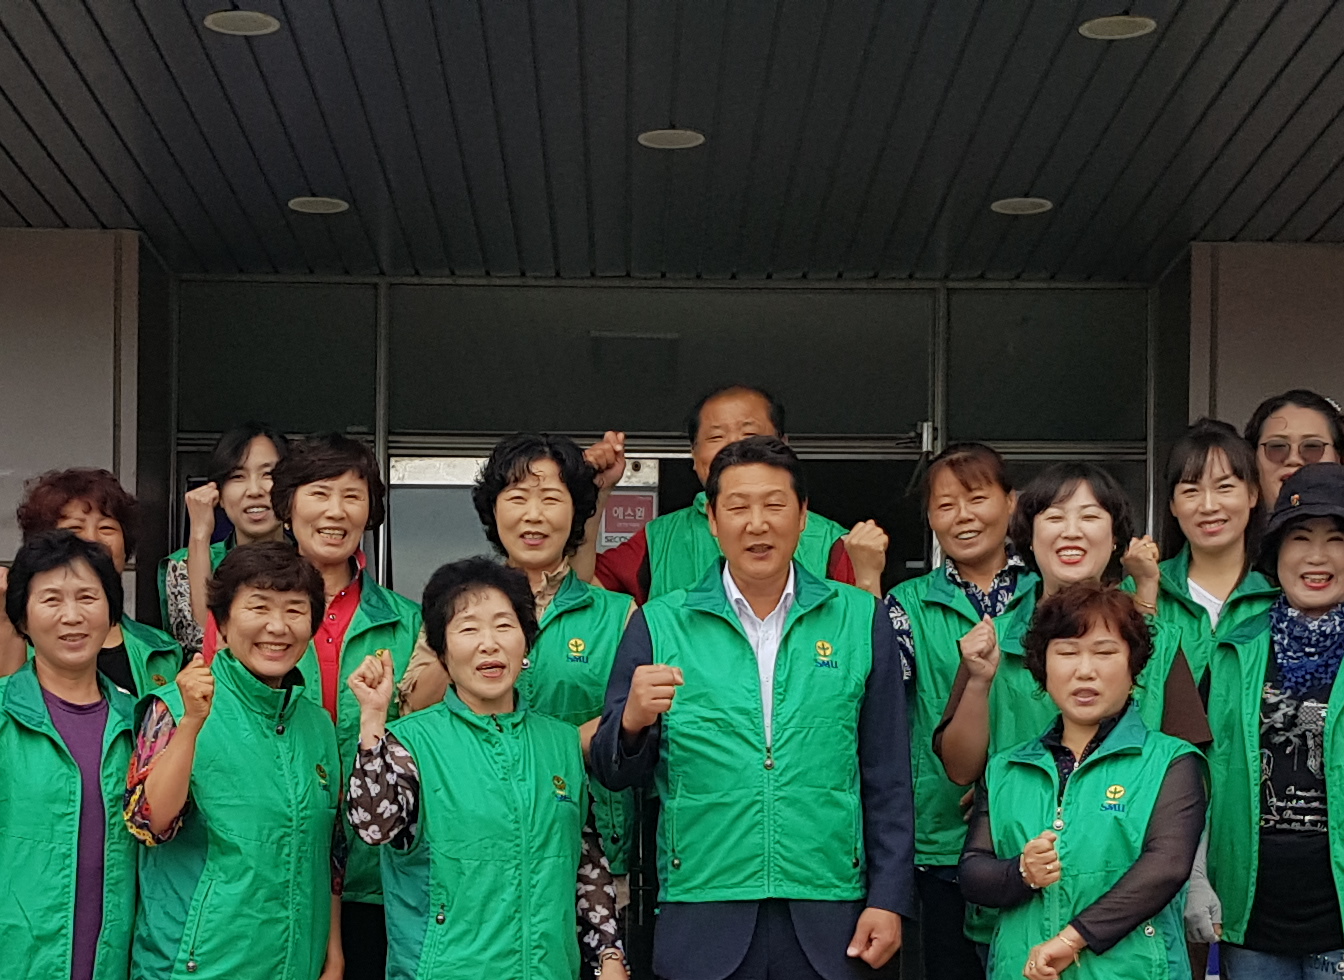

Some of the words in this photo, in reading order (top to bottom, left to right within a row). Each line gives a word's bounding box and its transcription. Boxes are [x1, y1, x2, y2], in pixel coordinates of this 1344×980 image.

[612, 506, 645, 520] 에스원
[566, 655, 590, 665] SMU
[814, 659, 838, 669] SMU
[1099, 803, 1126, 813] SMU
